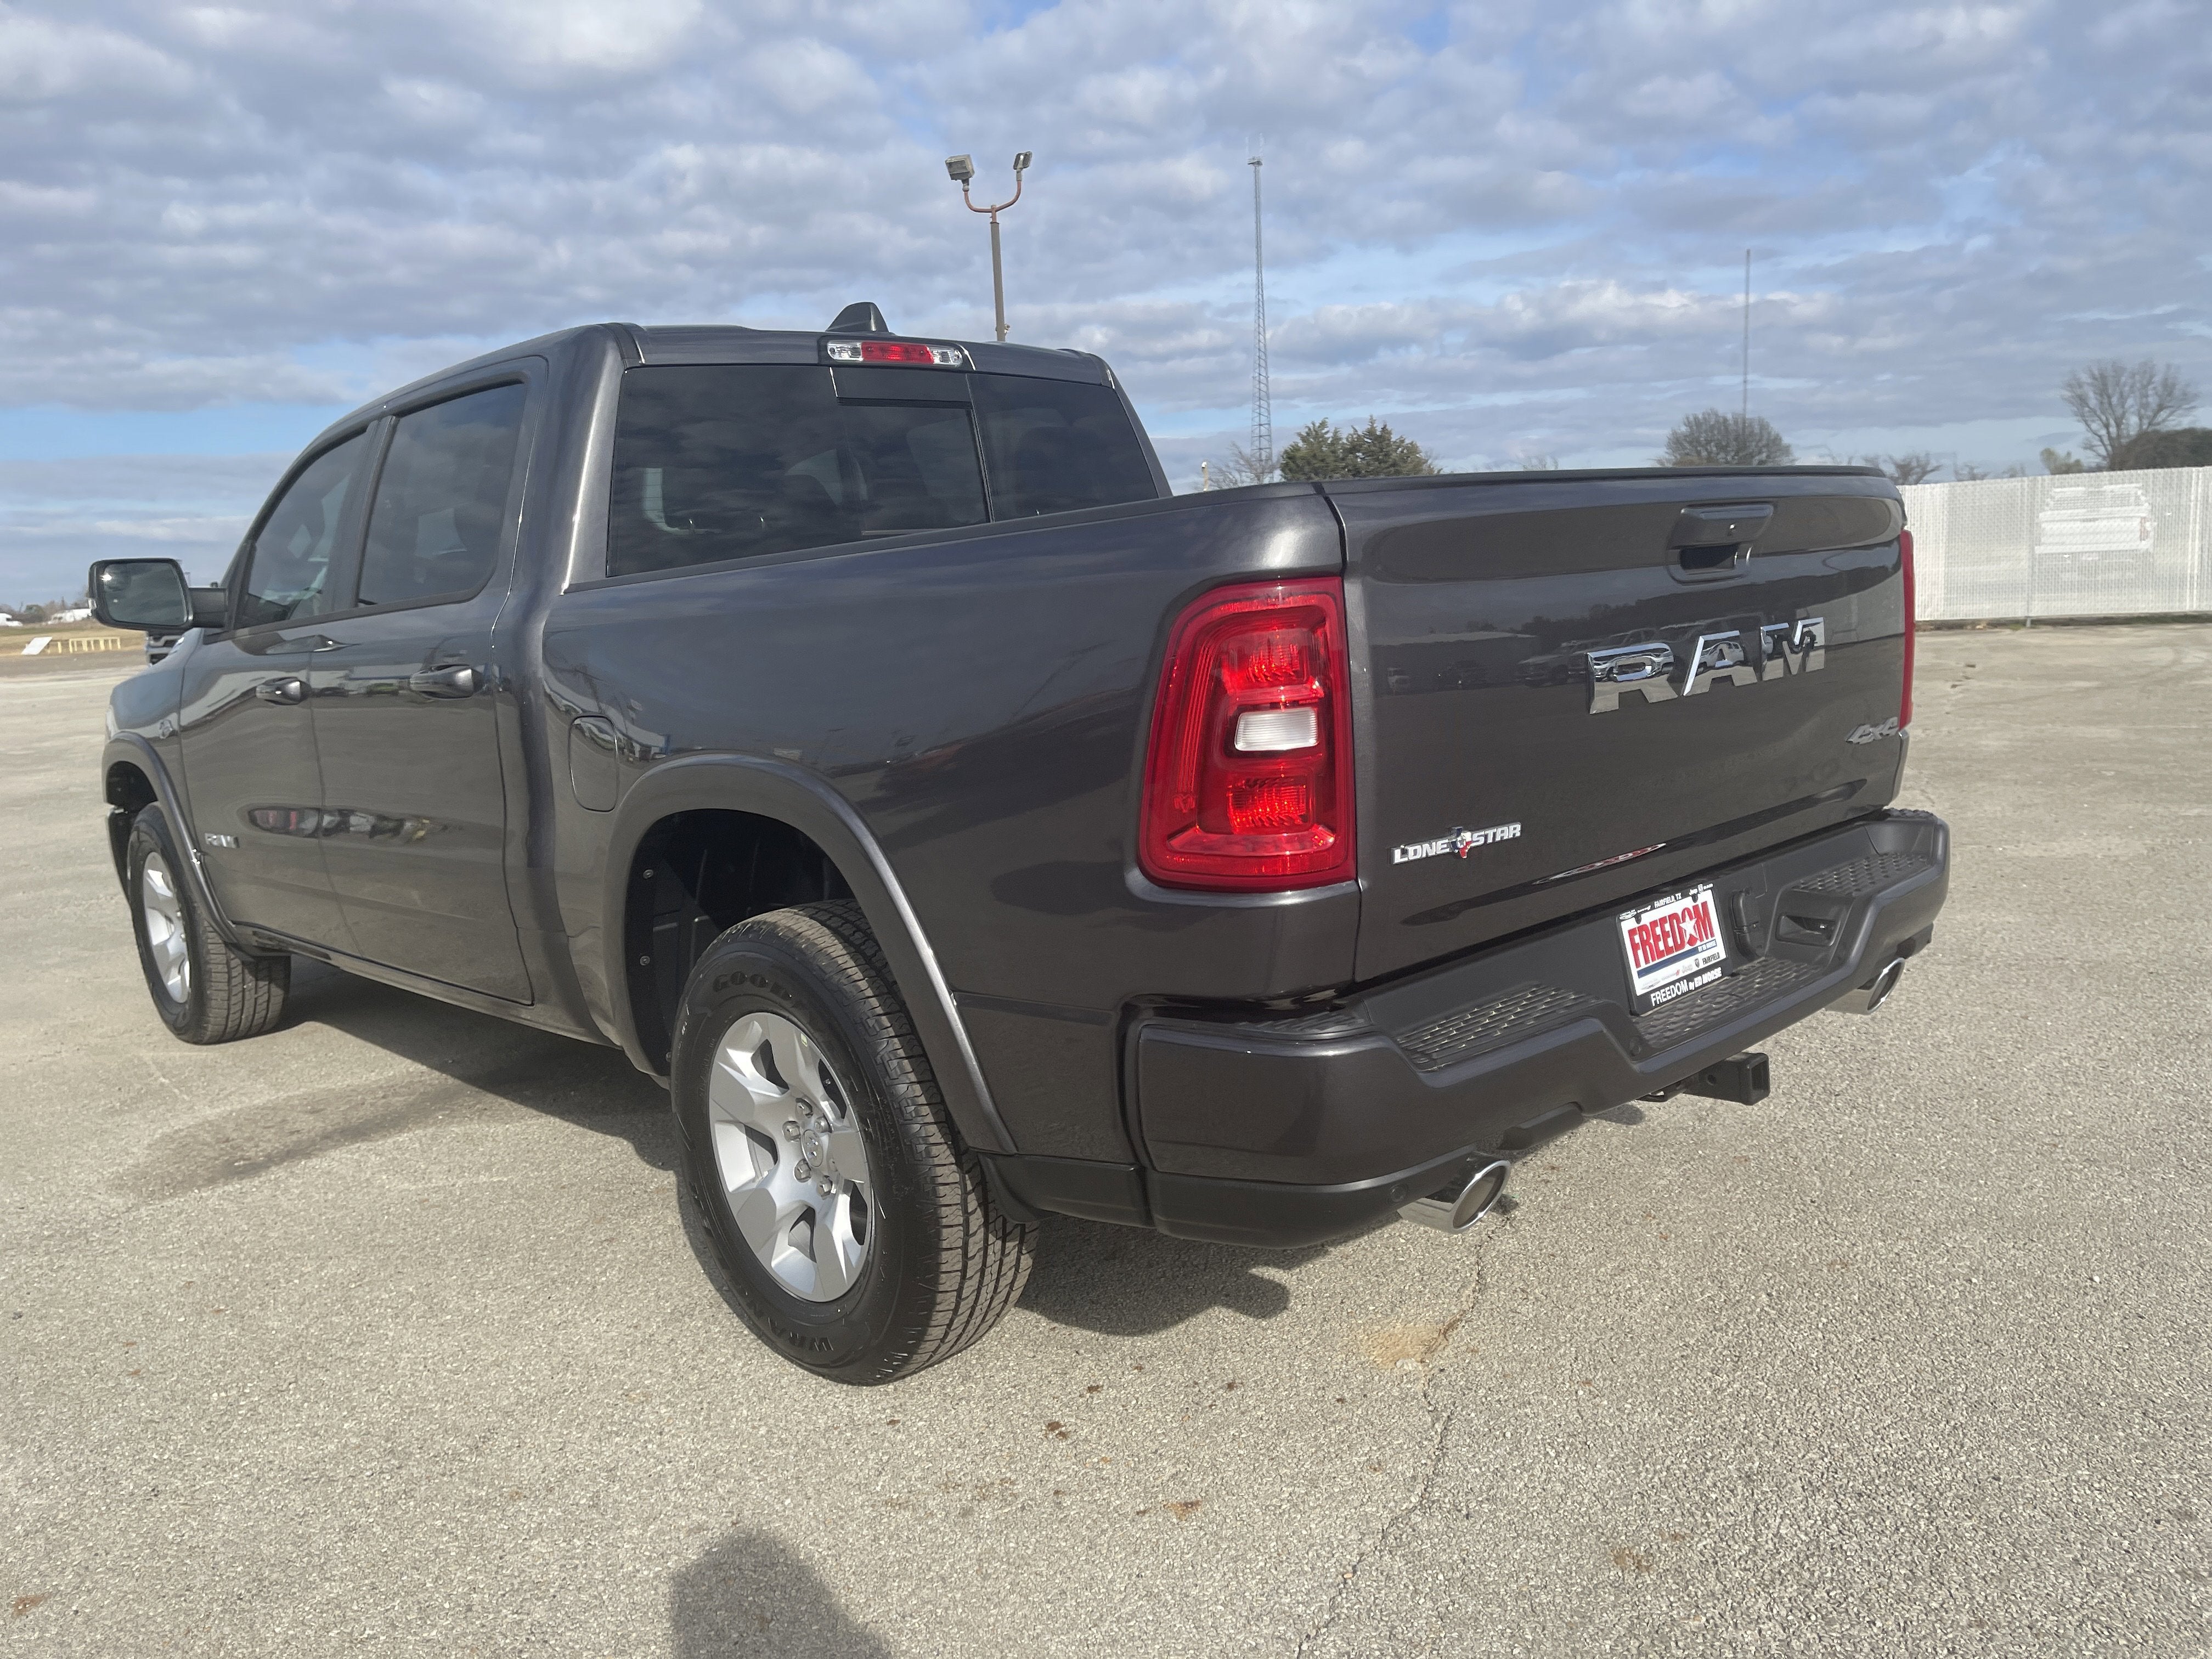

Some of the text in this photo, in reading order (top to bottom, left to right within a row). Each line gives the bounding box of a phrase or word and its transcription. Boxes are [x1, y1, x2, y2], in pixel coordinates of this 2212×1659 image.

[1587, 617, 1825, 714] RAM
[1393, 823, 1522, 864] LONE STAR
[1628, 901, 1715, 969] FREEDOM
[1702, 952, 1720, 966] FAIRFIELD
[1650, 979, 1689, 1007] FREEDOM
[1694, 976, 1702, 988] ED
[1702, 967, 1723, 984] MORSE
